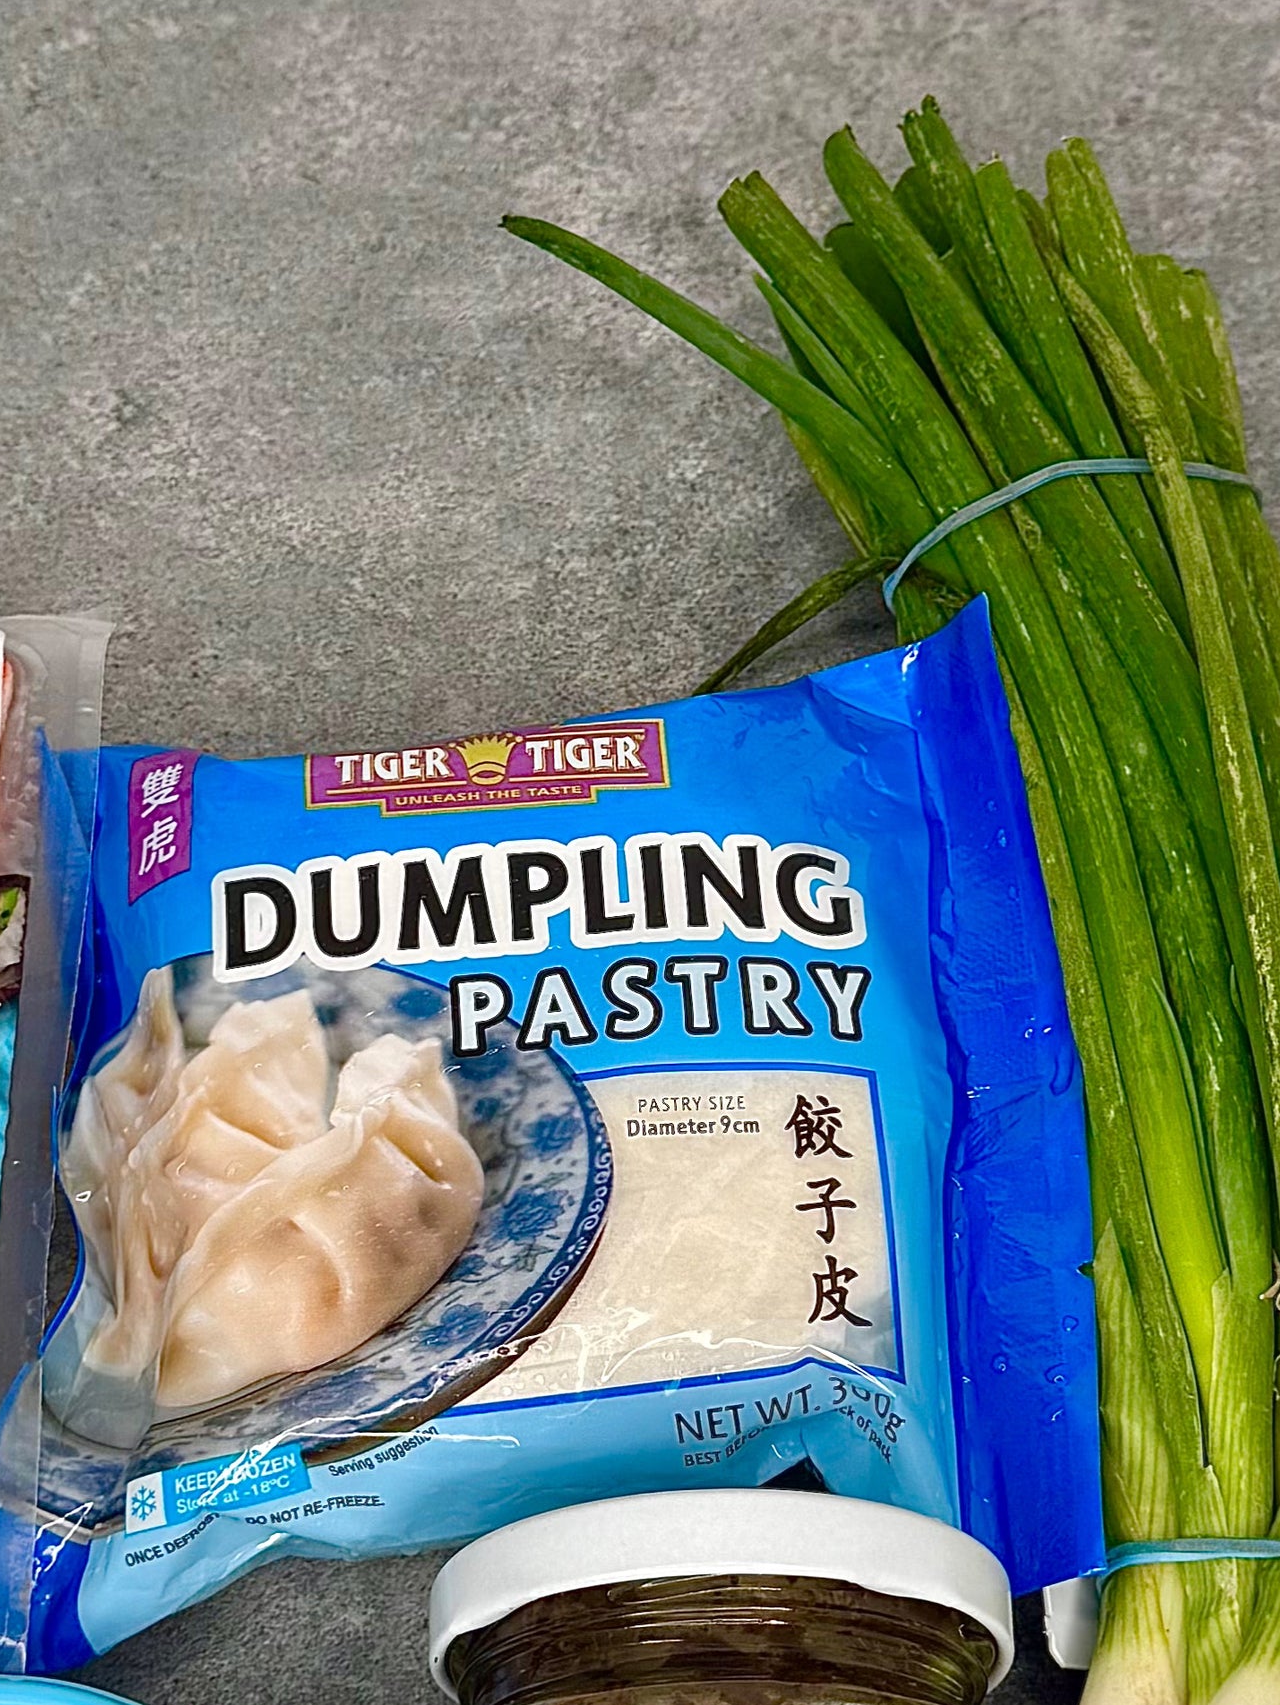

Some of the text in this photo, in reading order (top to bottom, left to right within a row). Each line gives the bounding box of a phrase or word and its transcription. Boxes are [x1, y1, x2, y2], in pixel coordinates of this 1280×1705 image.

[334, 735, 642, 784] TIGER TIGER
[139, 763, 185, 875] 雙虎
[395, 784, 583, 807] UNLEASH THE TASTE
[222, 841, 854, 971] DUMPLING
[449, 954, 872, 1058] PASTRY
[626, 1115, 761, 1137] Diameter 9cm
[638, 1095, 746, 1114] PASTRY SIZE
[784, 1094, 873, 1328] 餃子皮
[674, 1403, 745, 1444] NET
[755, 1383, 821, 1425] WT.
[328, 1424, 439, 1477] Serving suggestion
[683, 1450, 721, 1467] BEST
[175, 1468, 218, 1495] KEEP
[223, 1489, 240, 1504] at
[125, 1547, 164, 1568] ONCE
[245, 1513, 268, 1525] DO
[270, 1506, 300, 1524] NOT
